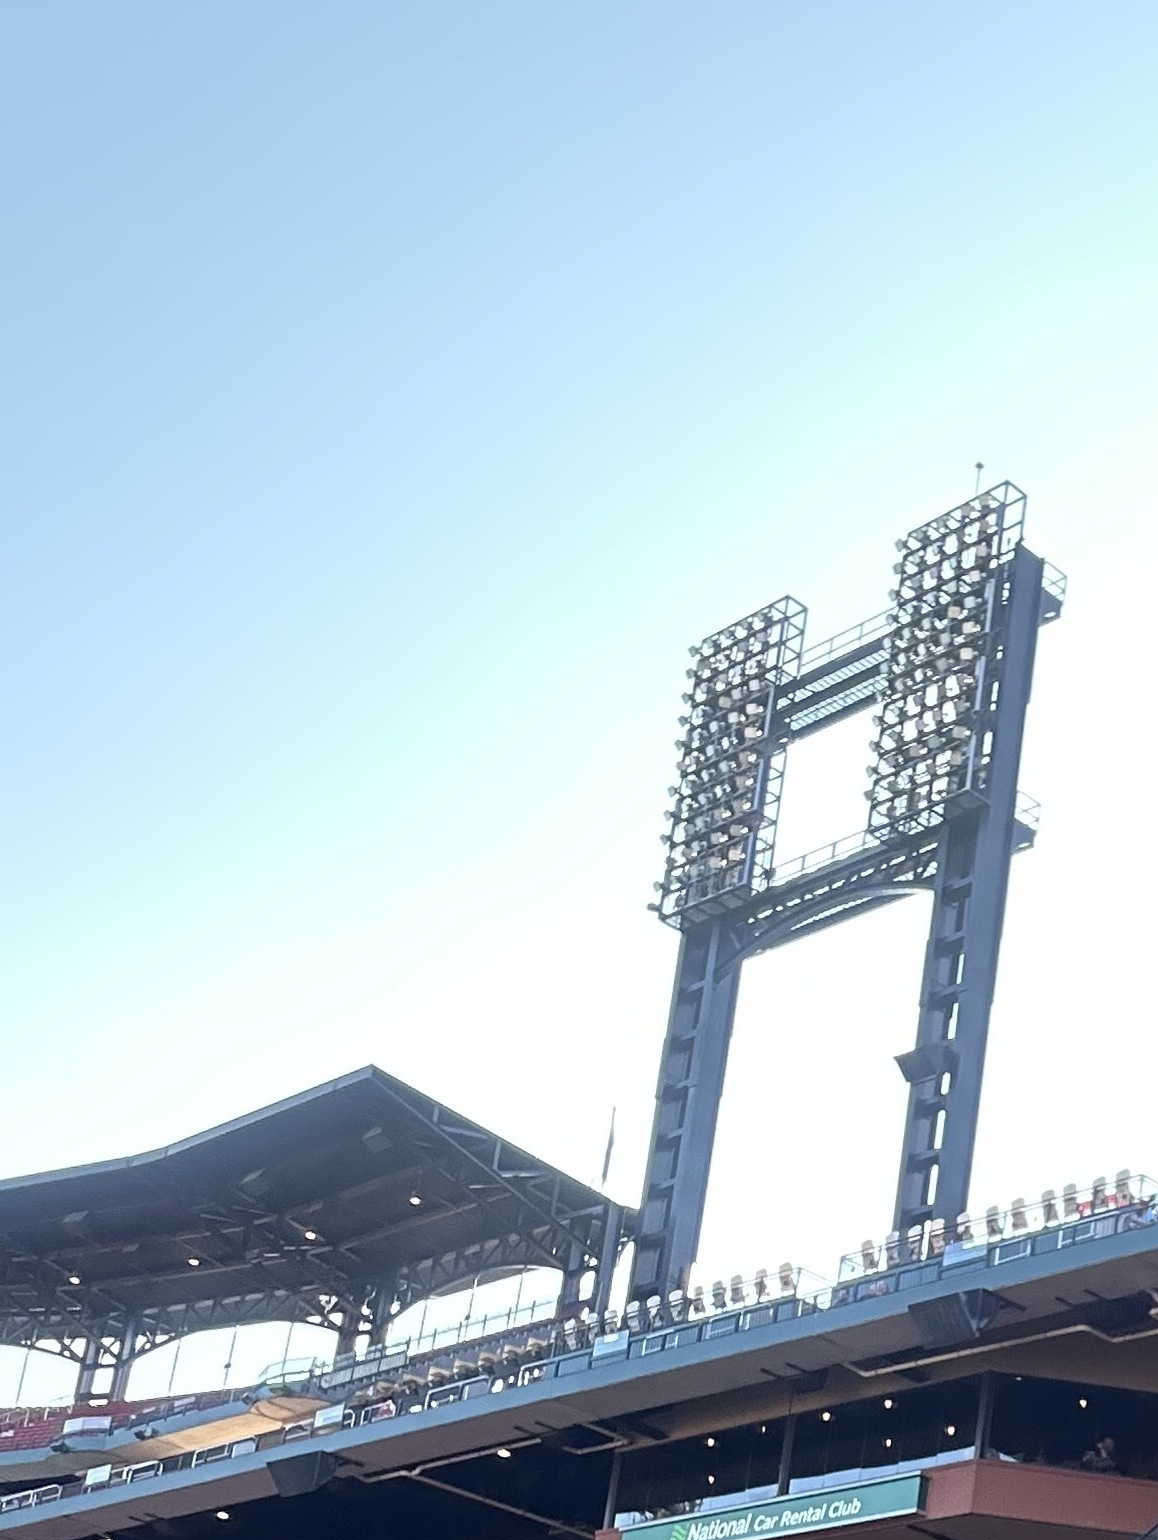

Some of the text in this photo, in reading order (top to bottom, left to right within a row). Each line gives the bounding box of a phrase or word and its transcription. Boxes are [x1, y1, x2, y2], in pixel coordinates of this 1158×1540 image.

[753, 1514, 779, 1531] Car
[780, 1503, 826, 1527] Rental
[828, 1497, 862, 1519] Club
